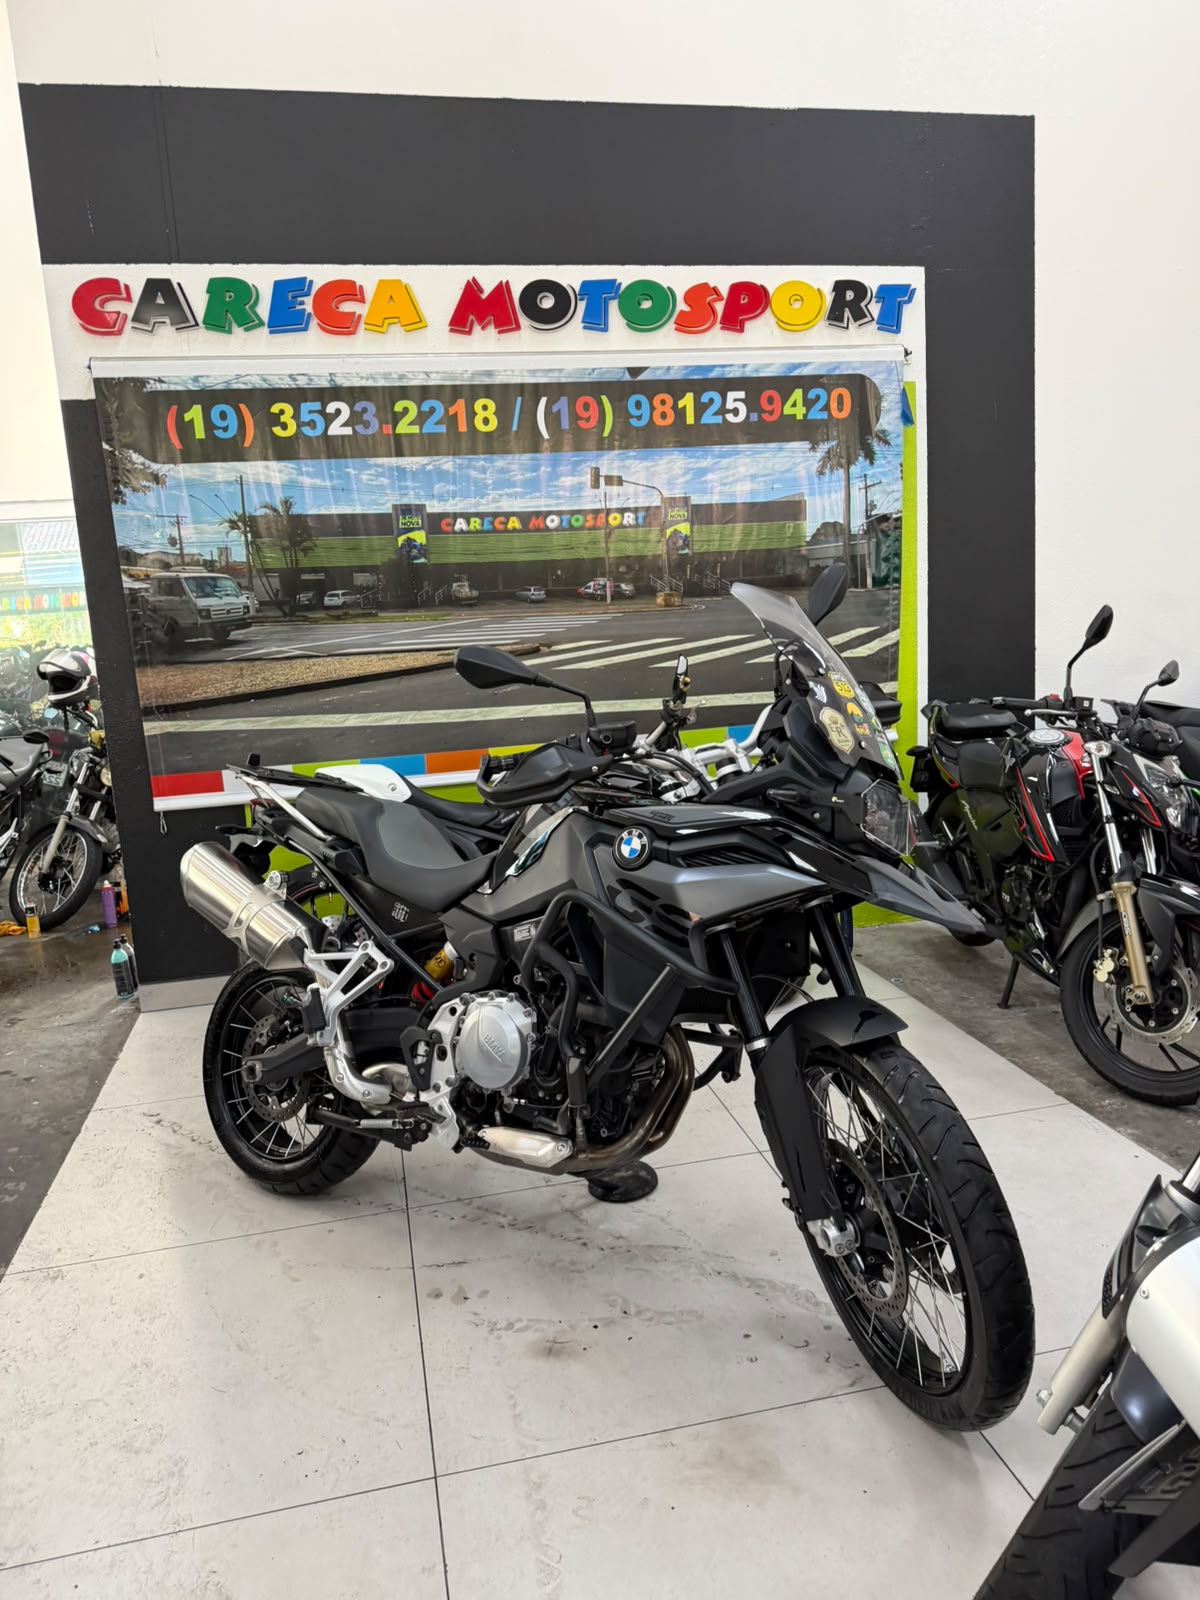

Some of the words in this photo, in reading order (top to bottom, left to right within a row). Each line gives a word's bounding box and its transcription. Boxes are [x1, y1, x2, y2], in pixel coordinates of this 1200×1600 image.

[71, 276, 428, 336] CARECA
[449, 276, 917, 336] MOTOSPORT
[166, 403, 255, 450] (19)
[270, 398, 499, 438] 3523.2218
[511, 396, 523, 432] /
[536, 395, 614, 440] (19)
[627, 387, 852, 429] 98125.9420
[440, 516, 522, 533] CARECA
[528, 511, 647, 530] MOTOSPORT
